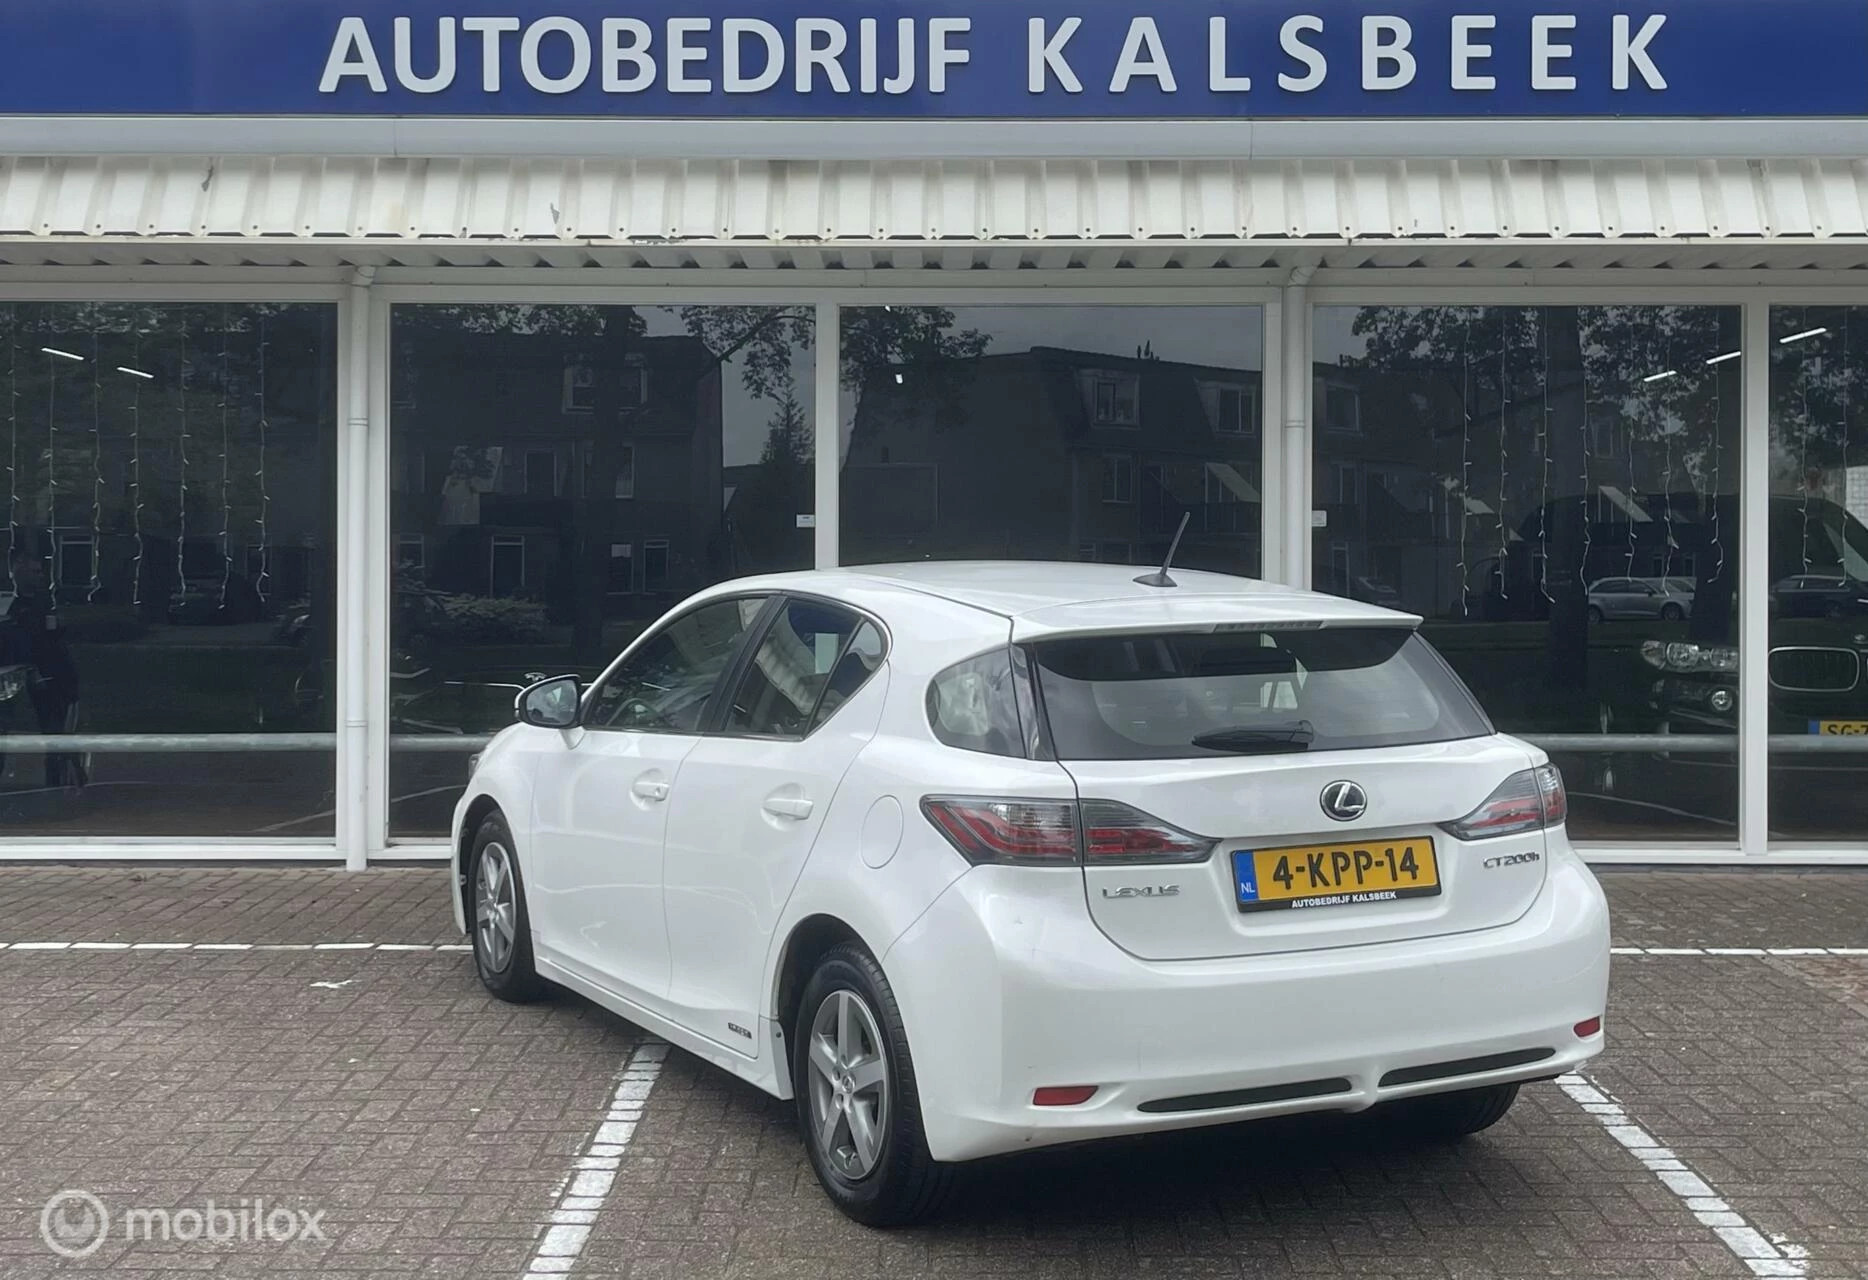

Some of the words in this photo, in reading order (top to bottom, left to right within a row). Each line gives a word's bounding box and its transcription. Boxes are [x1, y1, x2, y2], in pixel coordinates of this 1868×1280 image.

[318, 16, 971, 94] AUTOBEDRIJF
[1027, 15, 1668, 92] KALSBEEK
[1273, 847, 1419, 890] 4-KPP-14
[1102, 884, 1179, 899] LEXUS
[1240, 882, 1256, 893] NL
[1292, 896, 1350, 909] AUTOBEDRIJF
[1352, 891, 1397, 903] KALSBEEK
